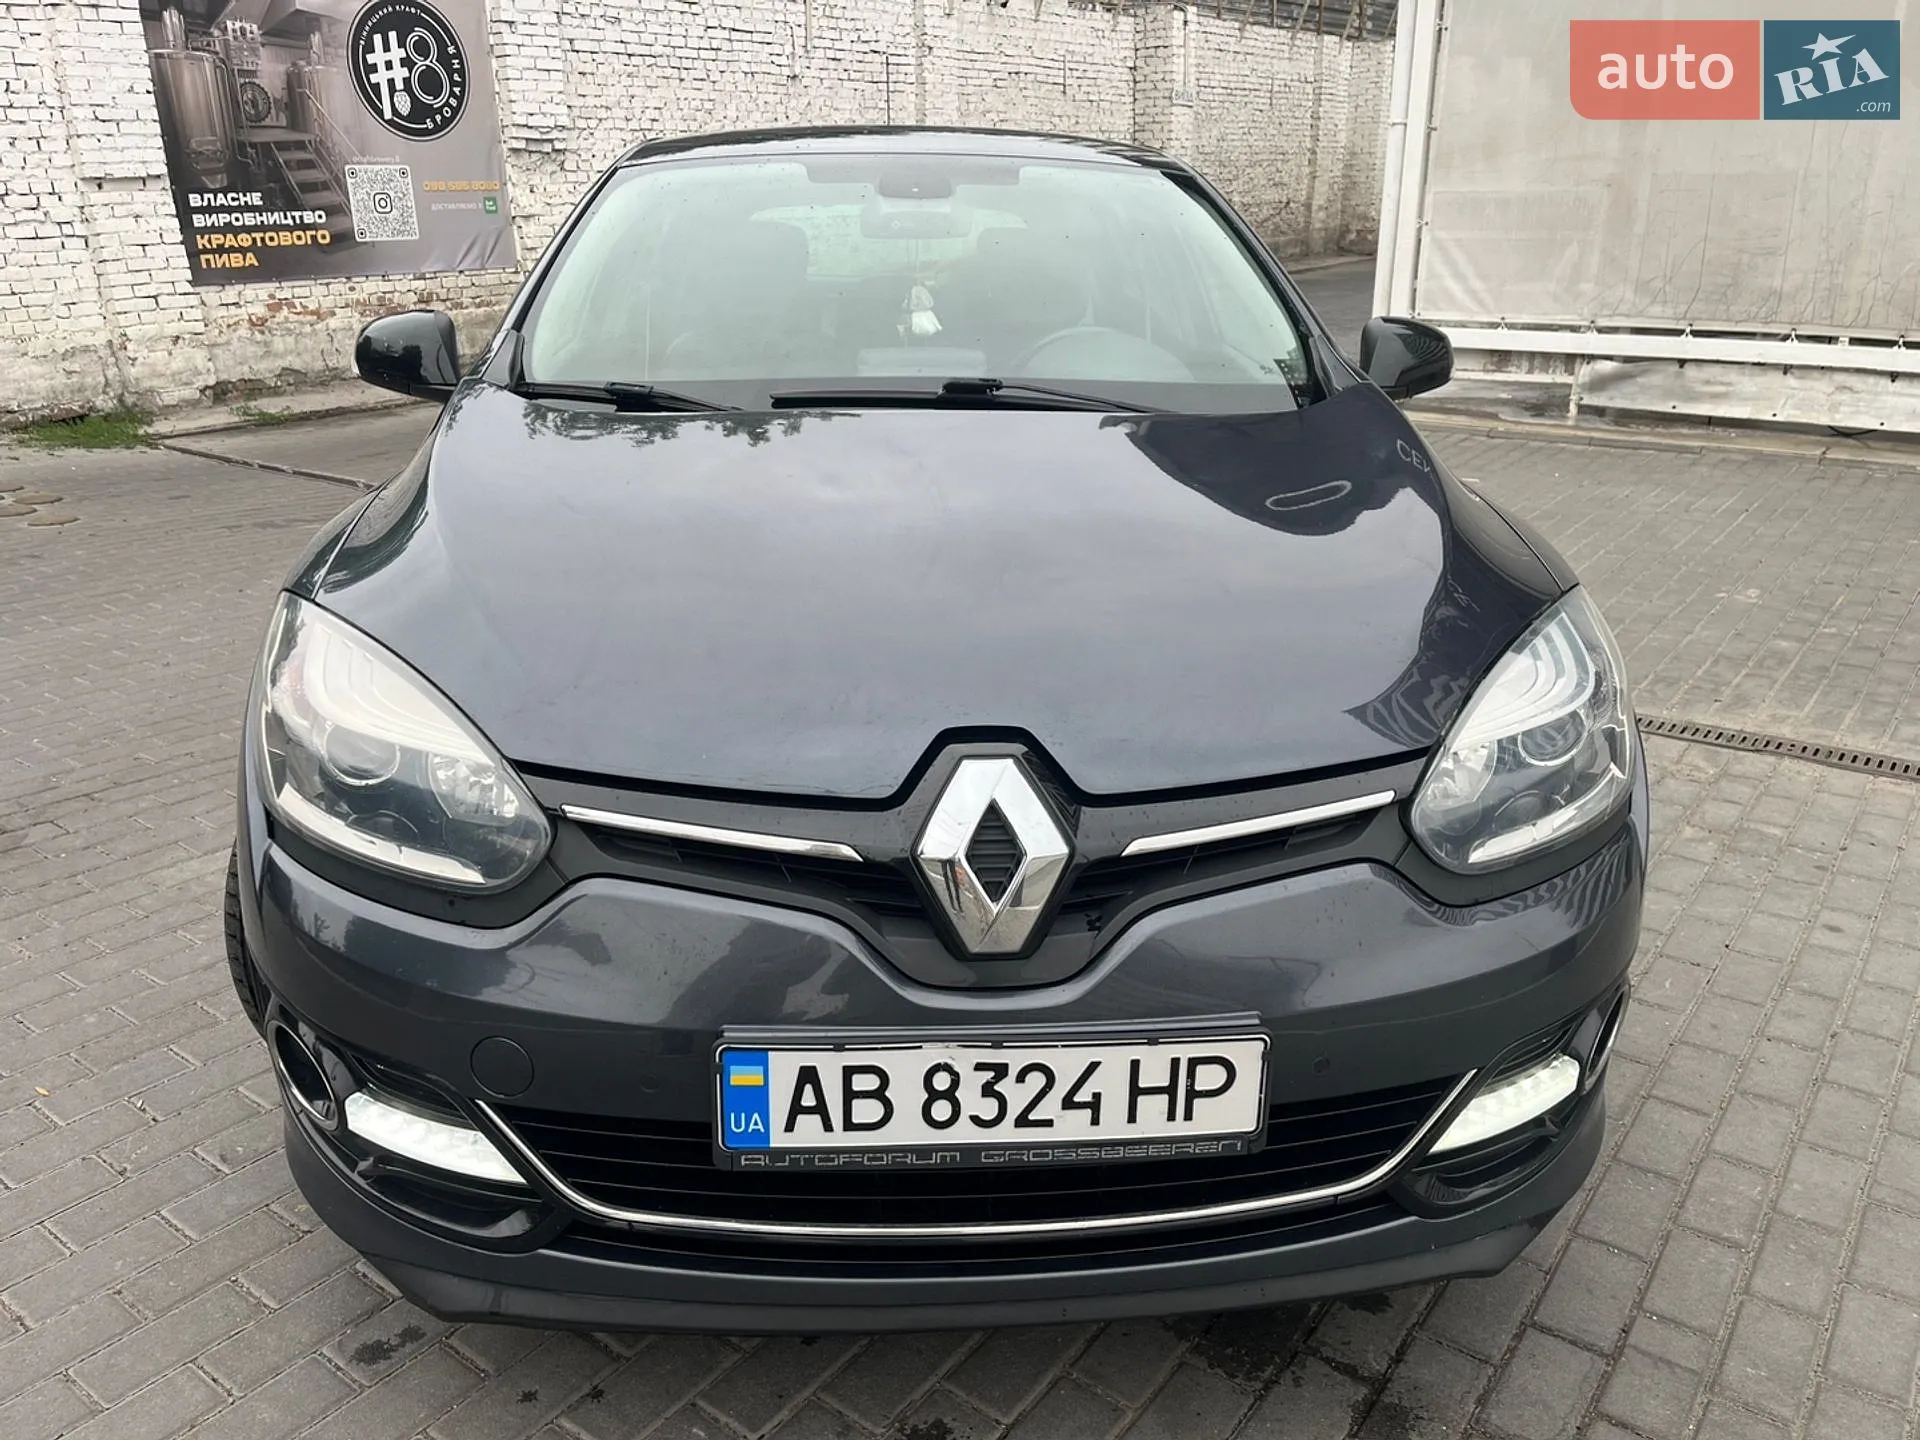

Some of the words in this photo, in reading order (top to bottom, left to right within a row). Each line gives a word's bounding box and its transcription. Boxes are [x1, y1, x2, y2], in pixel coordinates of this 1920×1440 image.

[365, 26, 450, 120] #8
[426, 44, 462, 130] БРОВАРНЯ
[188, 192, 264, 207] ВЛАСНЕ
[192, 210, 327, 227] ВИРОБНИЦТВО
[196, 229, 331, 249] КРАФТОВОГО
[200, 252, 259, 269] ПИВА
[784, 1064, 893, 1133] AB
[921, 1060, 1101, 1130] 8324
[1127, 1055, 1236, 1124] HP
[730, 1110, 764, 1133] UA
[740, 1151, 960, 1167] AUTOFORUM
